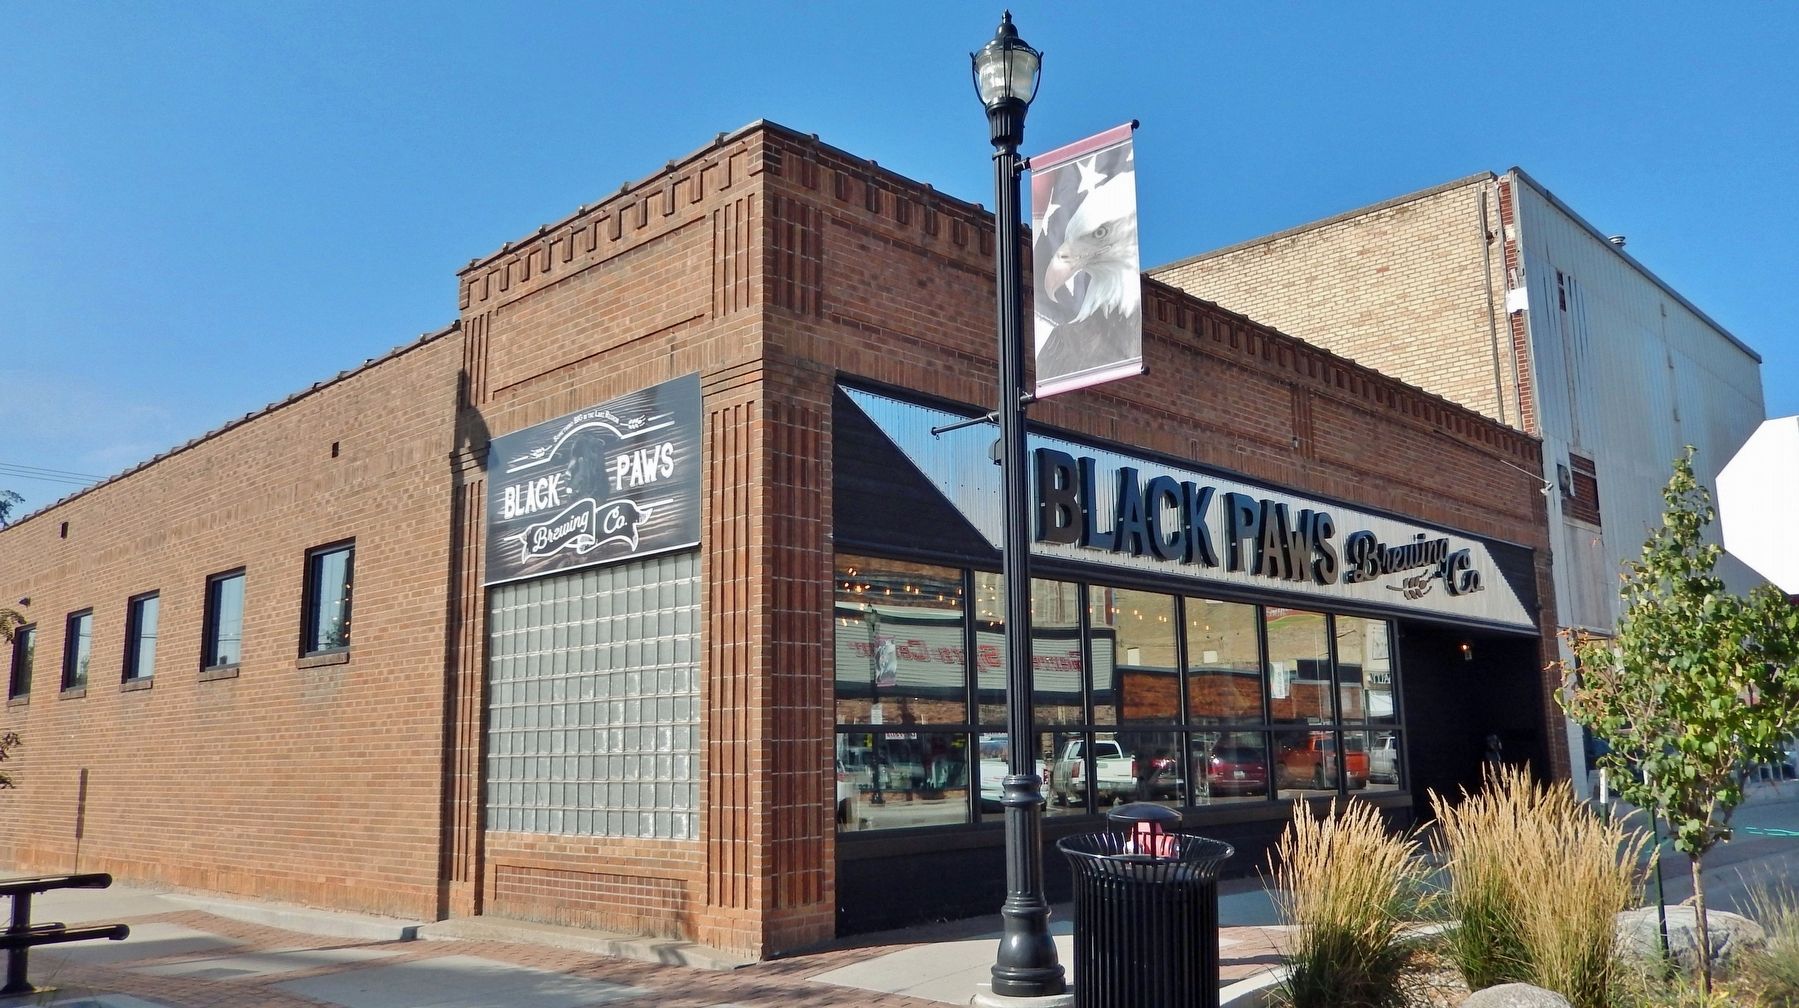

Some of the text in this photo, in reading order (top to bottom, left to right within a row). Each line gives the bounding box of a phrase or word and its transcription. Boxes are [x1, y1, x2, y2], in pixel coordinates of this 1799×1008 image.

[503, 442, 674, 520] BLACK PAWS
[532, 506, 628, 552] Brewing Co.
[1035, 447, 1485, 596] BLACK PAWS Brewing Co
